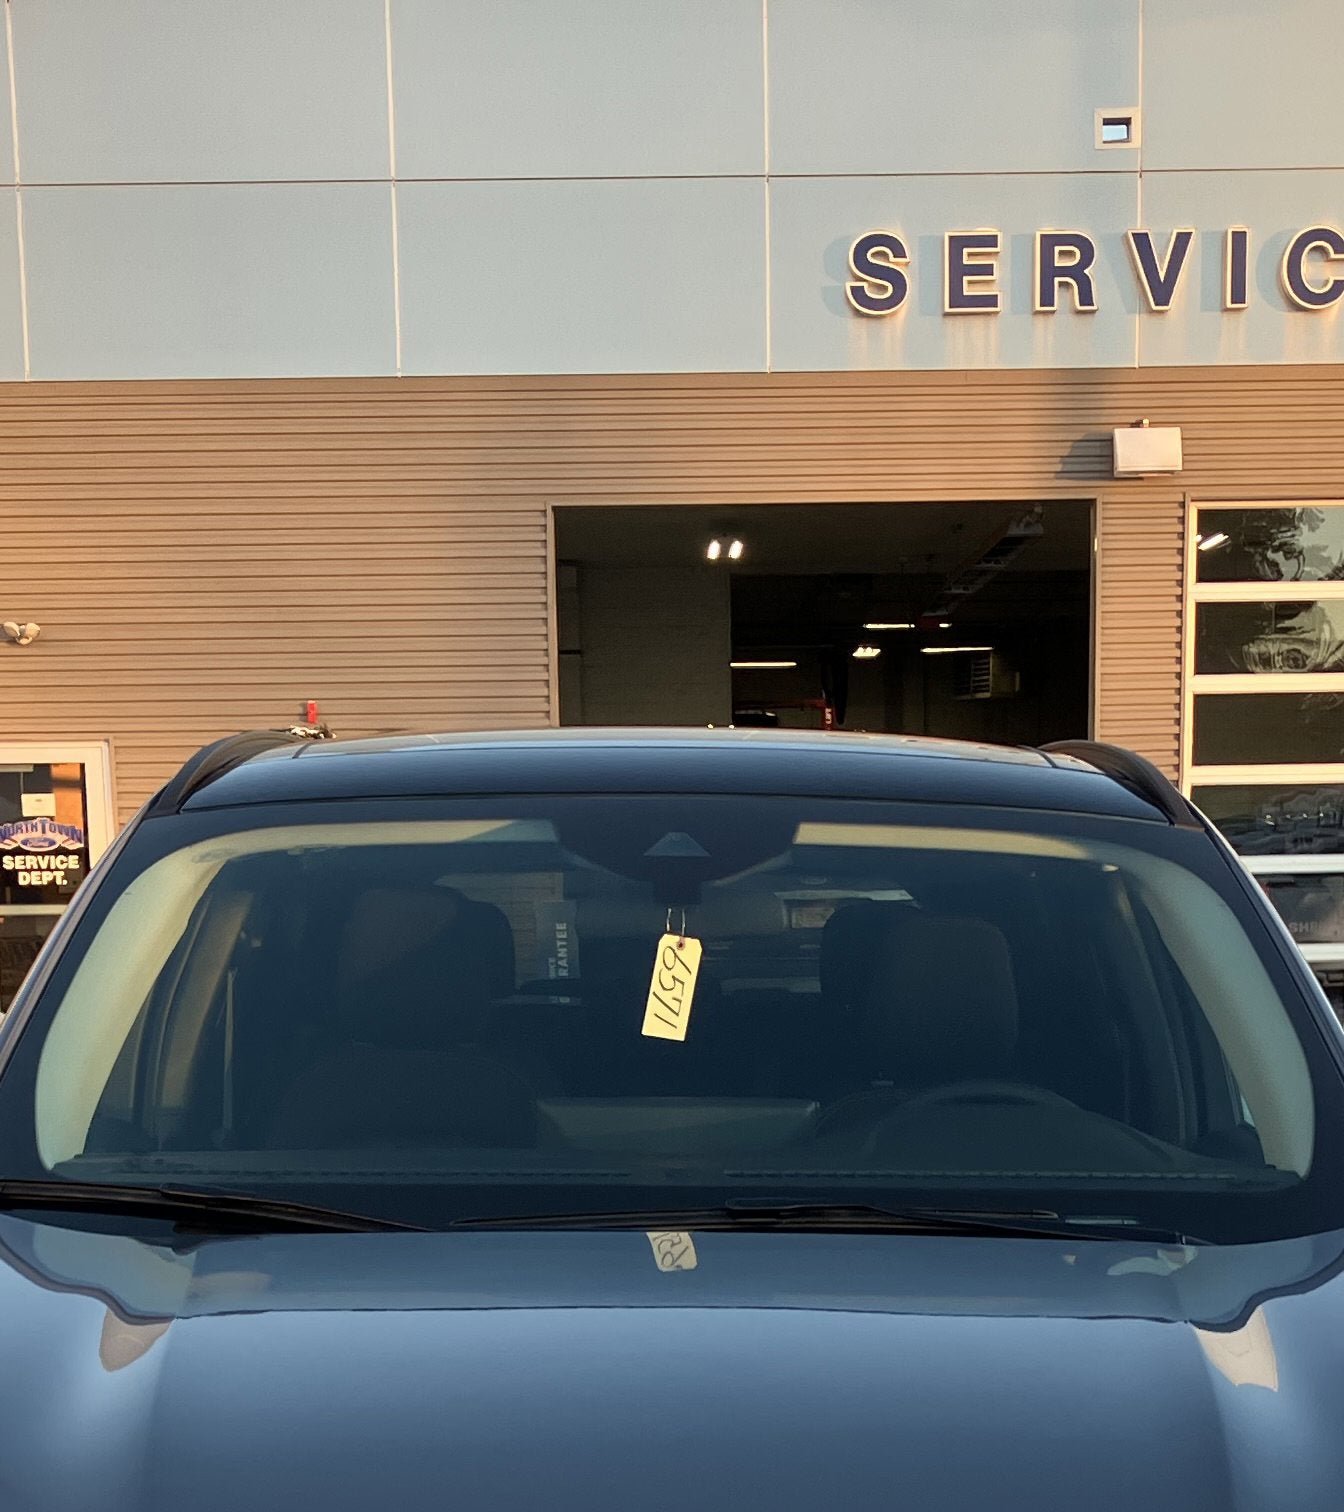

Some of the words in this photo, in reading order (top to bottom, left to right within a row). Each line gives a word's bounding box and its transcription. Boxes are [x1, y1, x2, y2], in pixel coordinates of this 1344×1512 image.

[2, 854, 80, 870] SERVICE
[18, 870, 68, 886] DEPT.
[652, 945, 692, 1030] 6571
